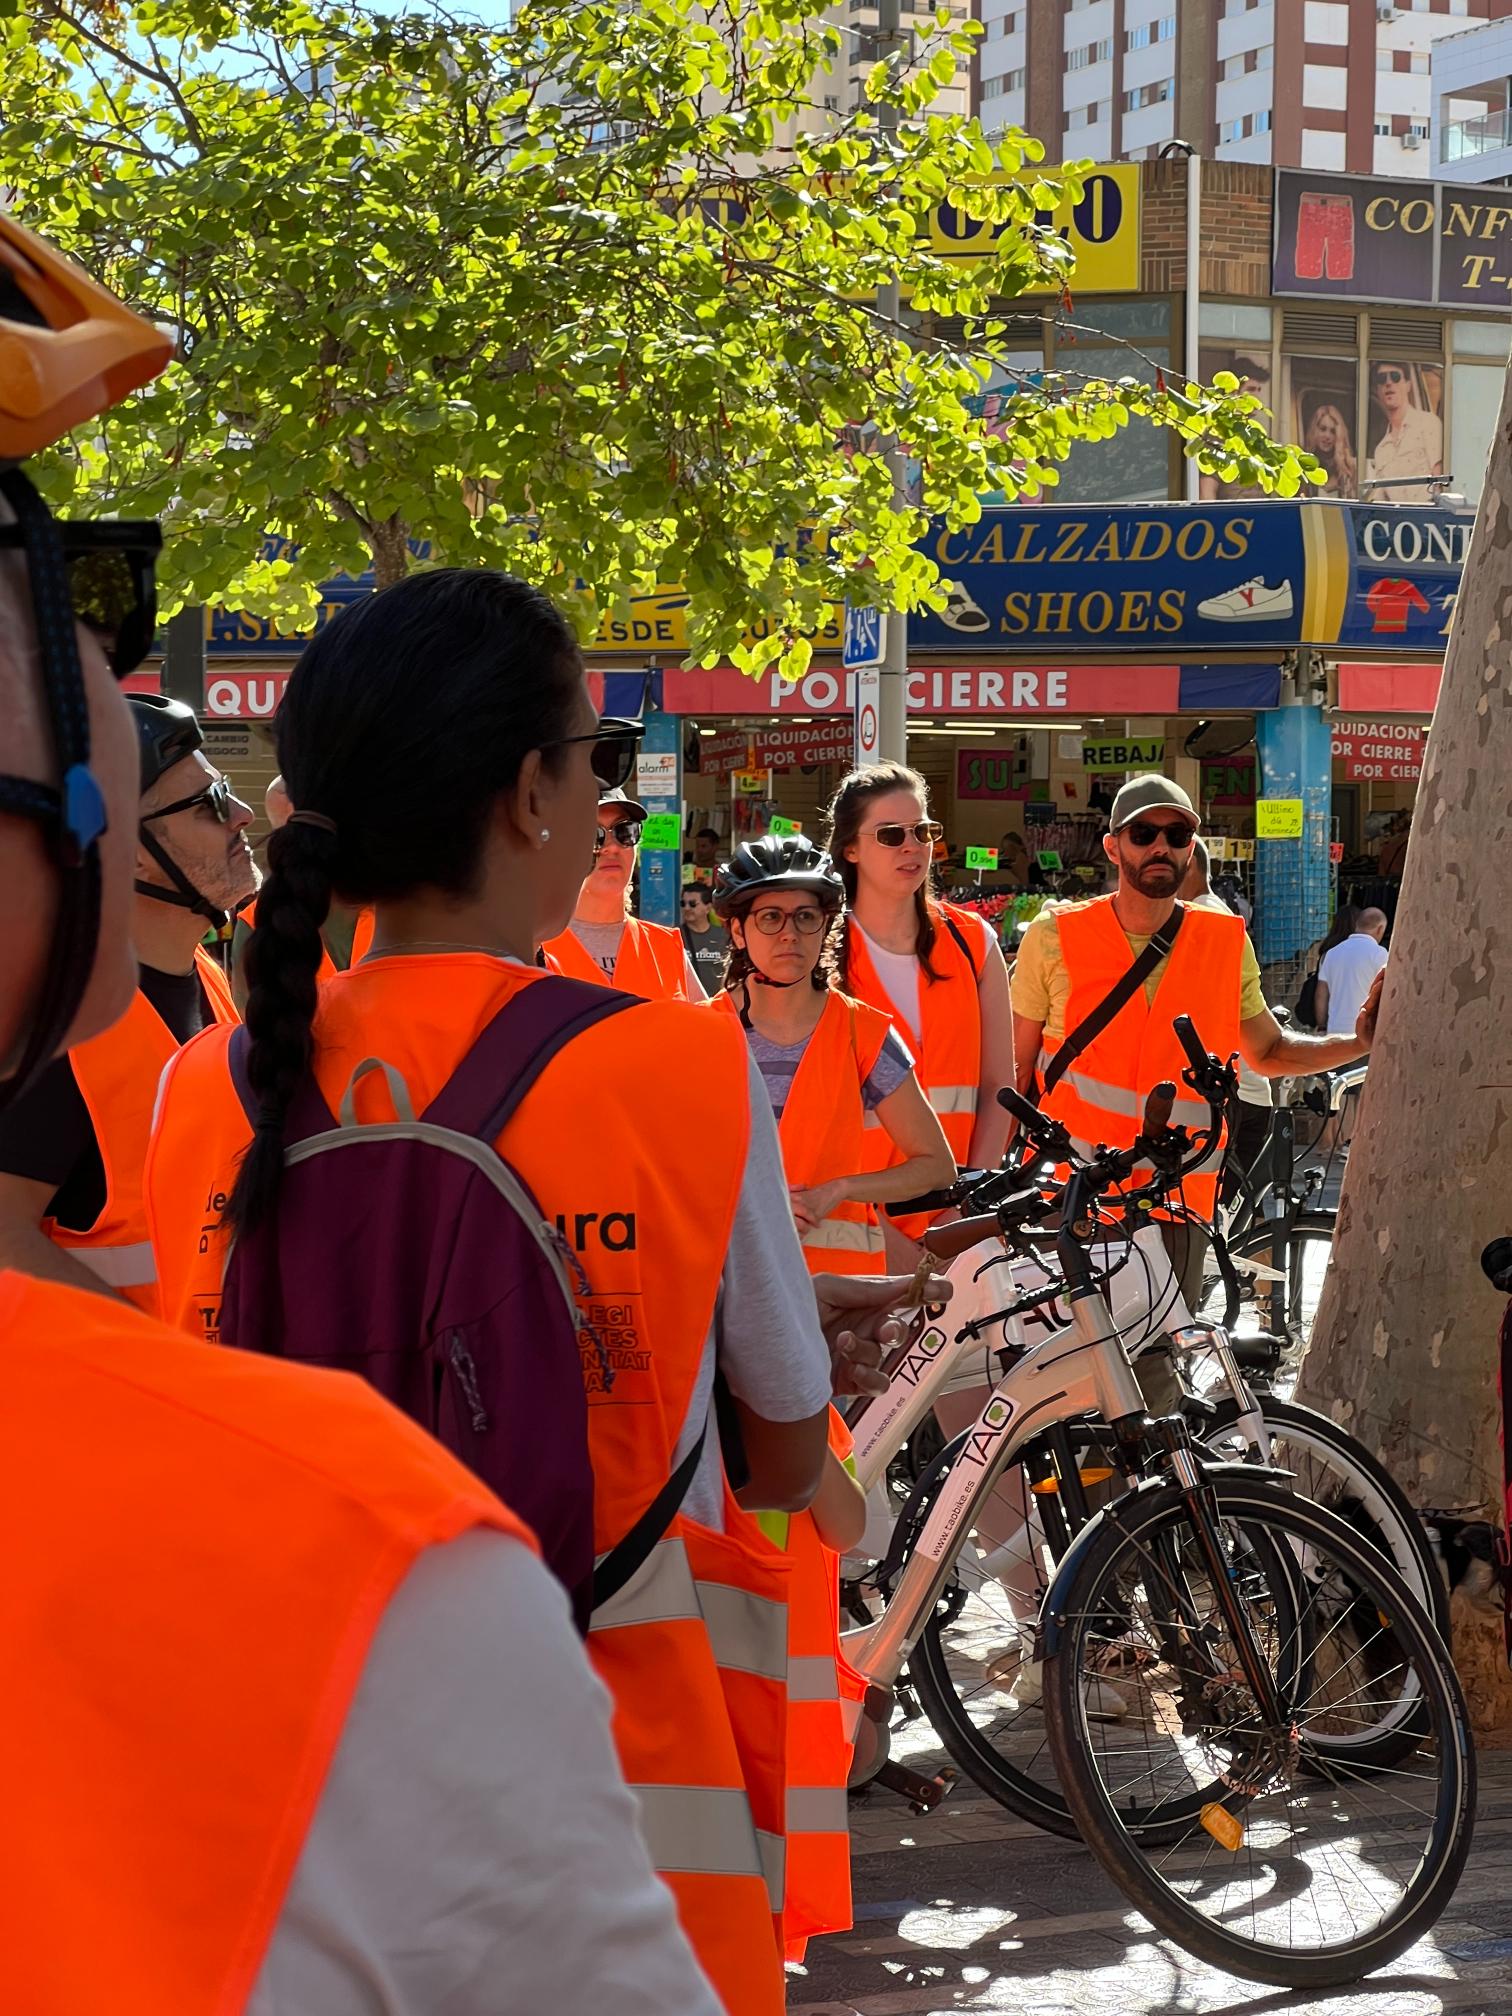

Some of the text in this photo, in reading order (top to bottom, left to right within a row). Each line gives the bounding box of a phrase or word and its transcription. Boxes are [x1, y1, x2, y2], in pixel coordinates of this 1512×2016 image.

[1462, 255, 1512, 290] T-
[936, 519, 1254, 565] CALZADOS
[1001, 589, 1186, 634] SHOES
[770, 671, 1068, 708] PO CIERRE
[206, 735, 249, 743] CAMBIO
[764, 745, 854, 765] POR CIERRE
[1361, 743, 1412, 760] CIERRE
[1354, 764, 1383, 777] POR
[890, 1326, 947, 1386] TAO
[861, 1396, 906, 1457] www.taobike.es
[956, 1396, 1014, 1467] TAO
[931, 1480, 976, 1557] www.taobike.es
